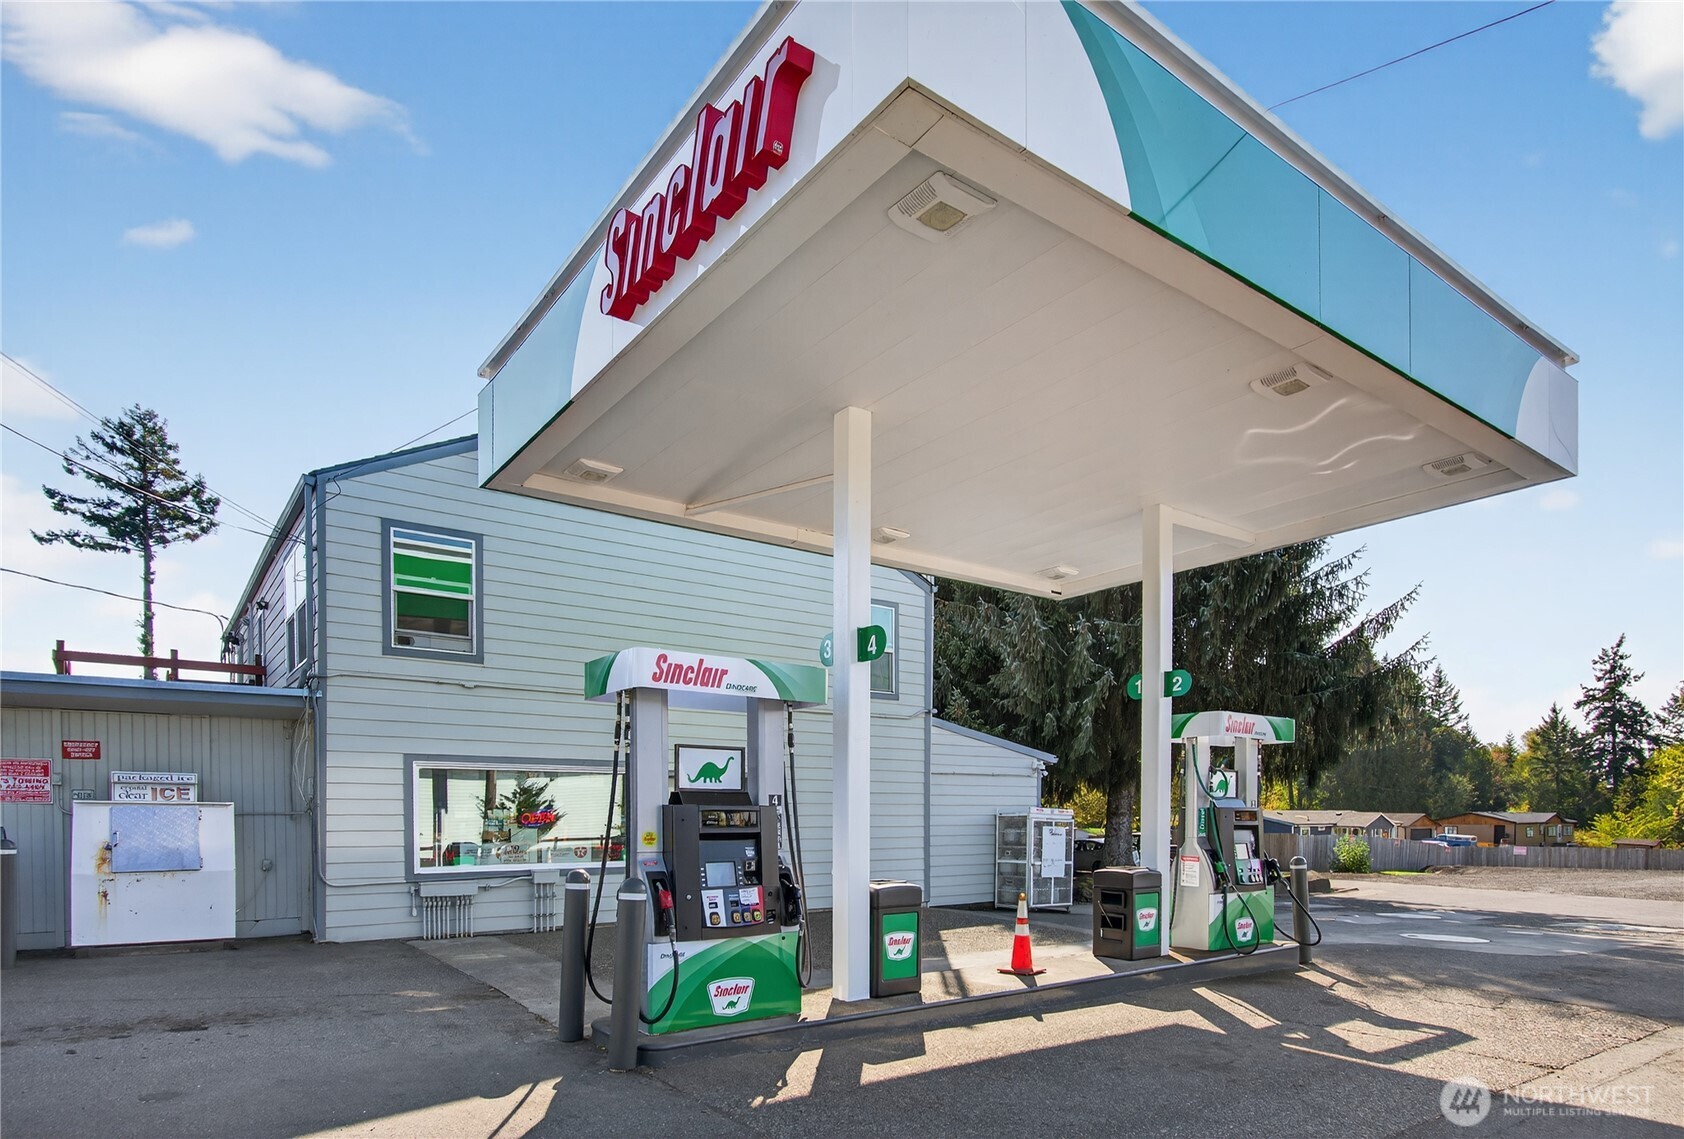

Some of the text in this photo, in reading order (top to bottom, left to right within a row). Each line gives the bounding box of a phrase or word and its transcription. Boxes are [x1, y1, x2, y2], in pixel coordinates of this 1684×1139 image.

[600, 35, 815, 322] Sinclair
[823, 639, 832, 659] 3
[867, 634, 877, 655] 4
[651, 653, 728, 689] Sinclair
[1135, 679, 1142, 694] 1
[1172, 676, 1183, 692] 2
[1225, 714, 1255, 735] Sinclair
[118, 790, 148, 800] clear
[151, 786, 191, 801] ICE
[772, 794, 779, 806] 4
[714, 983, 750, 998] Sinclair
